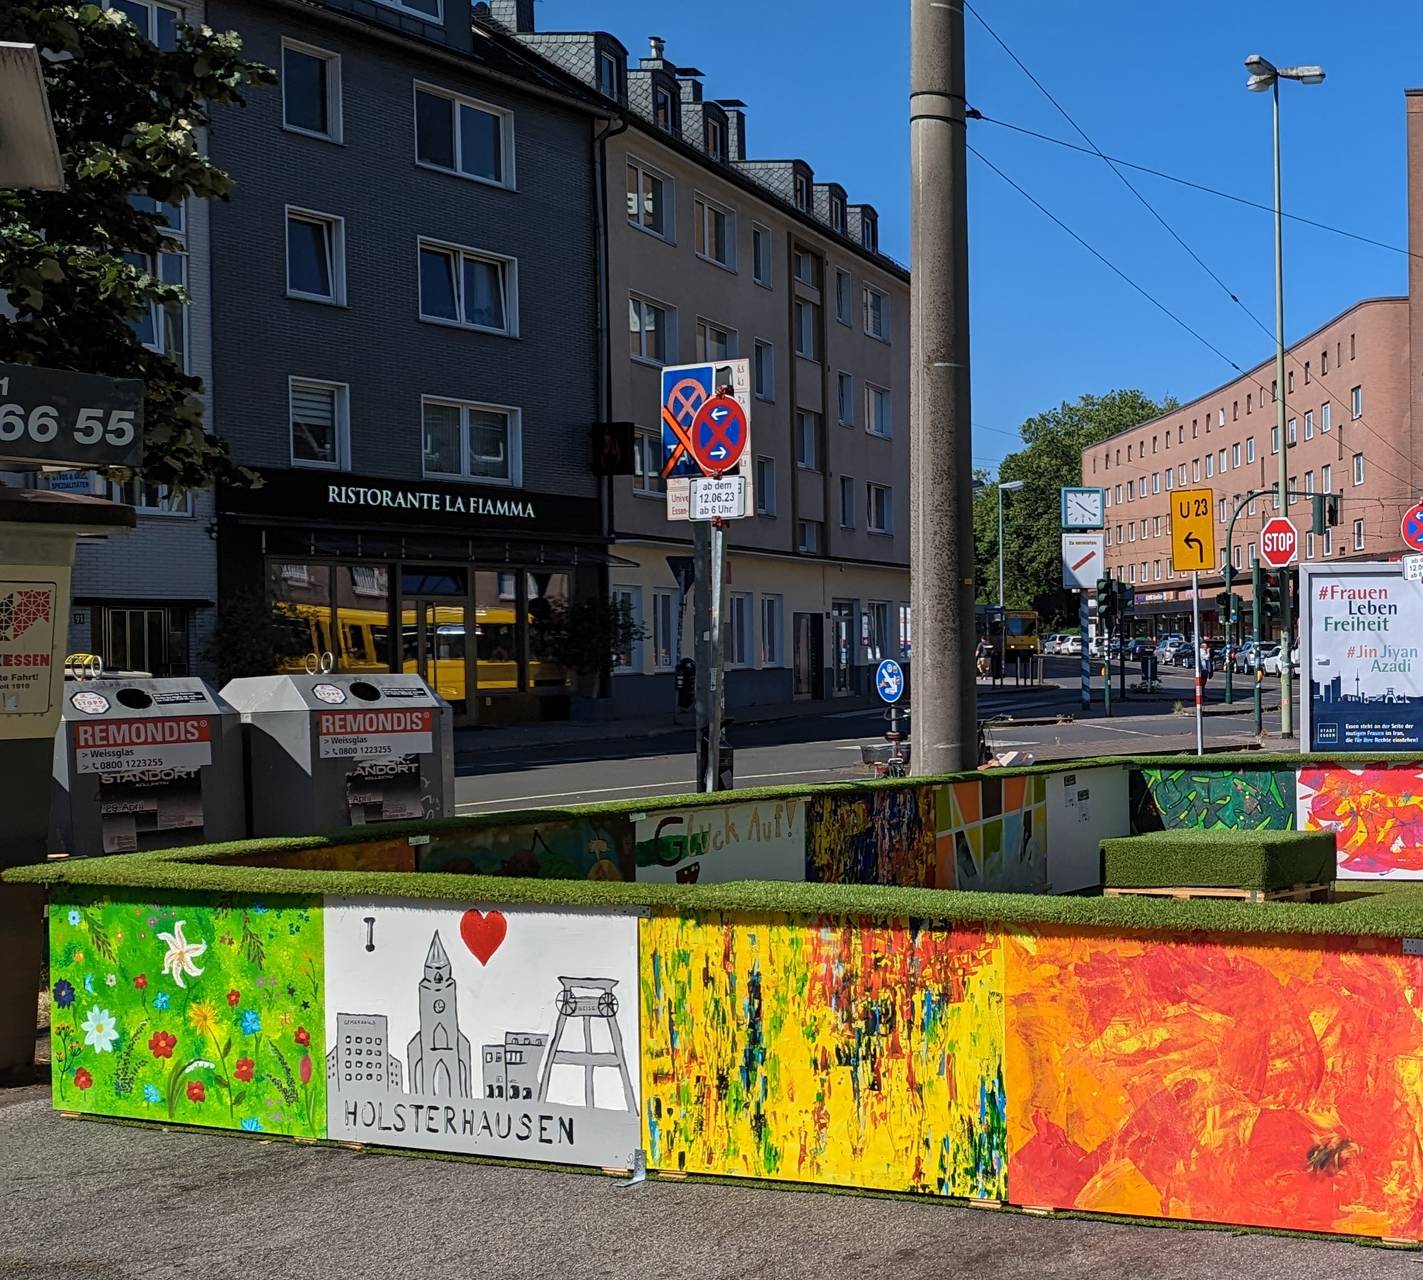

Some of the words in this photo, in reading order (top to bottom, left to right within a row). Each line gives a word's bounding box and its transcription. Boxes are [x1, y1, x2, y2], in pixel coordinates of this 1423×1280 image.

[0, 403, 59, 443] 66
[73, 407, 135, 447] 55
[702, 482, 713, 491] ab
[714, 481, 732, 490] dem
[327, 485, 441, 511] RISTORANTE
[445, 495, 466, 513] LA
[469, 497, 536, 518] FIAMMA
[671, 493, 689, 503] Unive
[699, 492, 735, 504] 12.06.23
[699, 505, 711, 515] ab
[711, 505, 716, 514] 6
[717, 504, 733, 514] Uhr
[1180, 501, 1190, 519] U
[1195, 498, 1209, 517] 23
[1264, 532, 1294, 552] STOP
[1319, 584, 1388, 600] #Frauen
[1348, 600, 1398, 615] Leben
[1324, 616, 1390, 632] Freiheit
[1347, 644, 1378, 658] #Jin
[1380, 644, 1418, 659] Jiyan
[1371, 659, 1411, 673] Azadi
[11, 673, 39, 682] Fahrt!
[331, 736, 368, 745] Weissglas
[90, 749, 135, 759] Weissglas
[360, 745, 392, 754] 1223255
[100, 761, 123, 770] 0800
[125, 758, 164, 768] 1223255
[353, 763, 419, 777] ANDORT
[100, 767, 197, 784] STANDORT
[363, 917, 376, 952] I
[344, 1100, 575, 1146] HOLSTERHAUSEN
